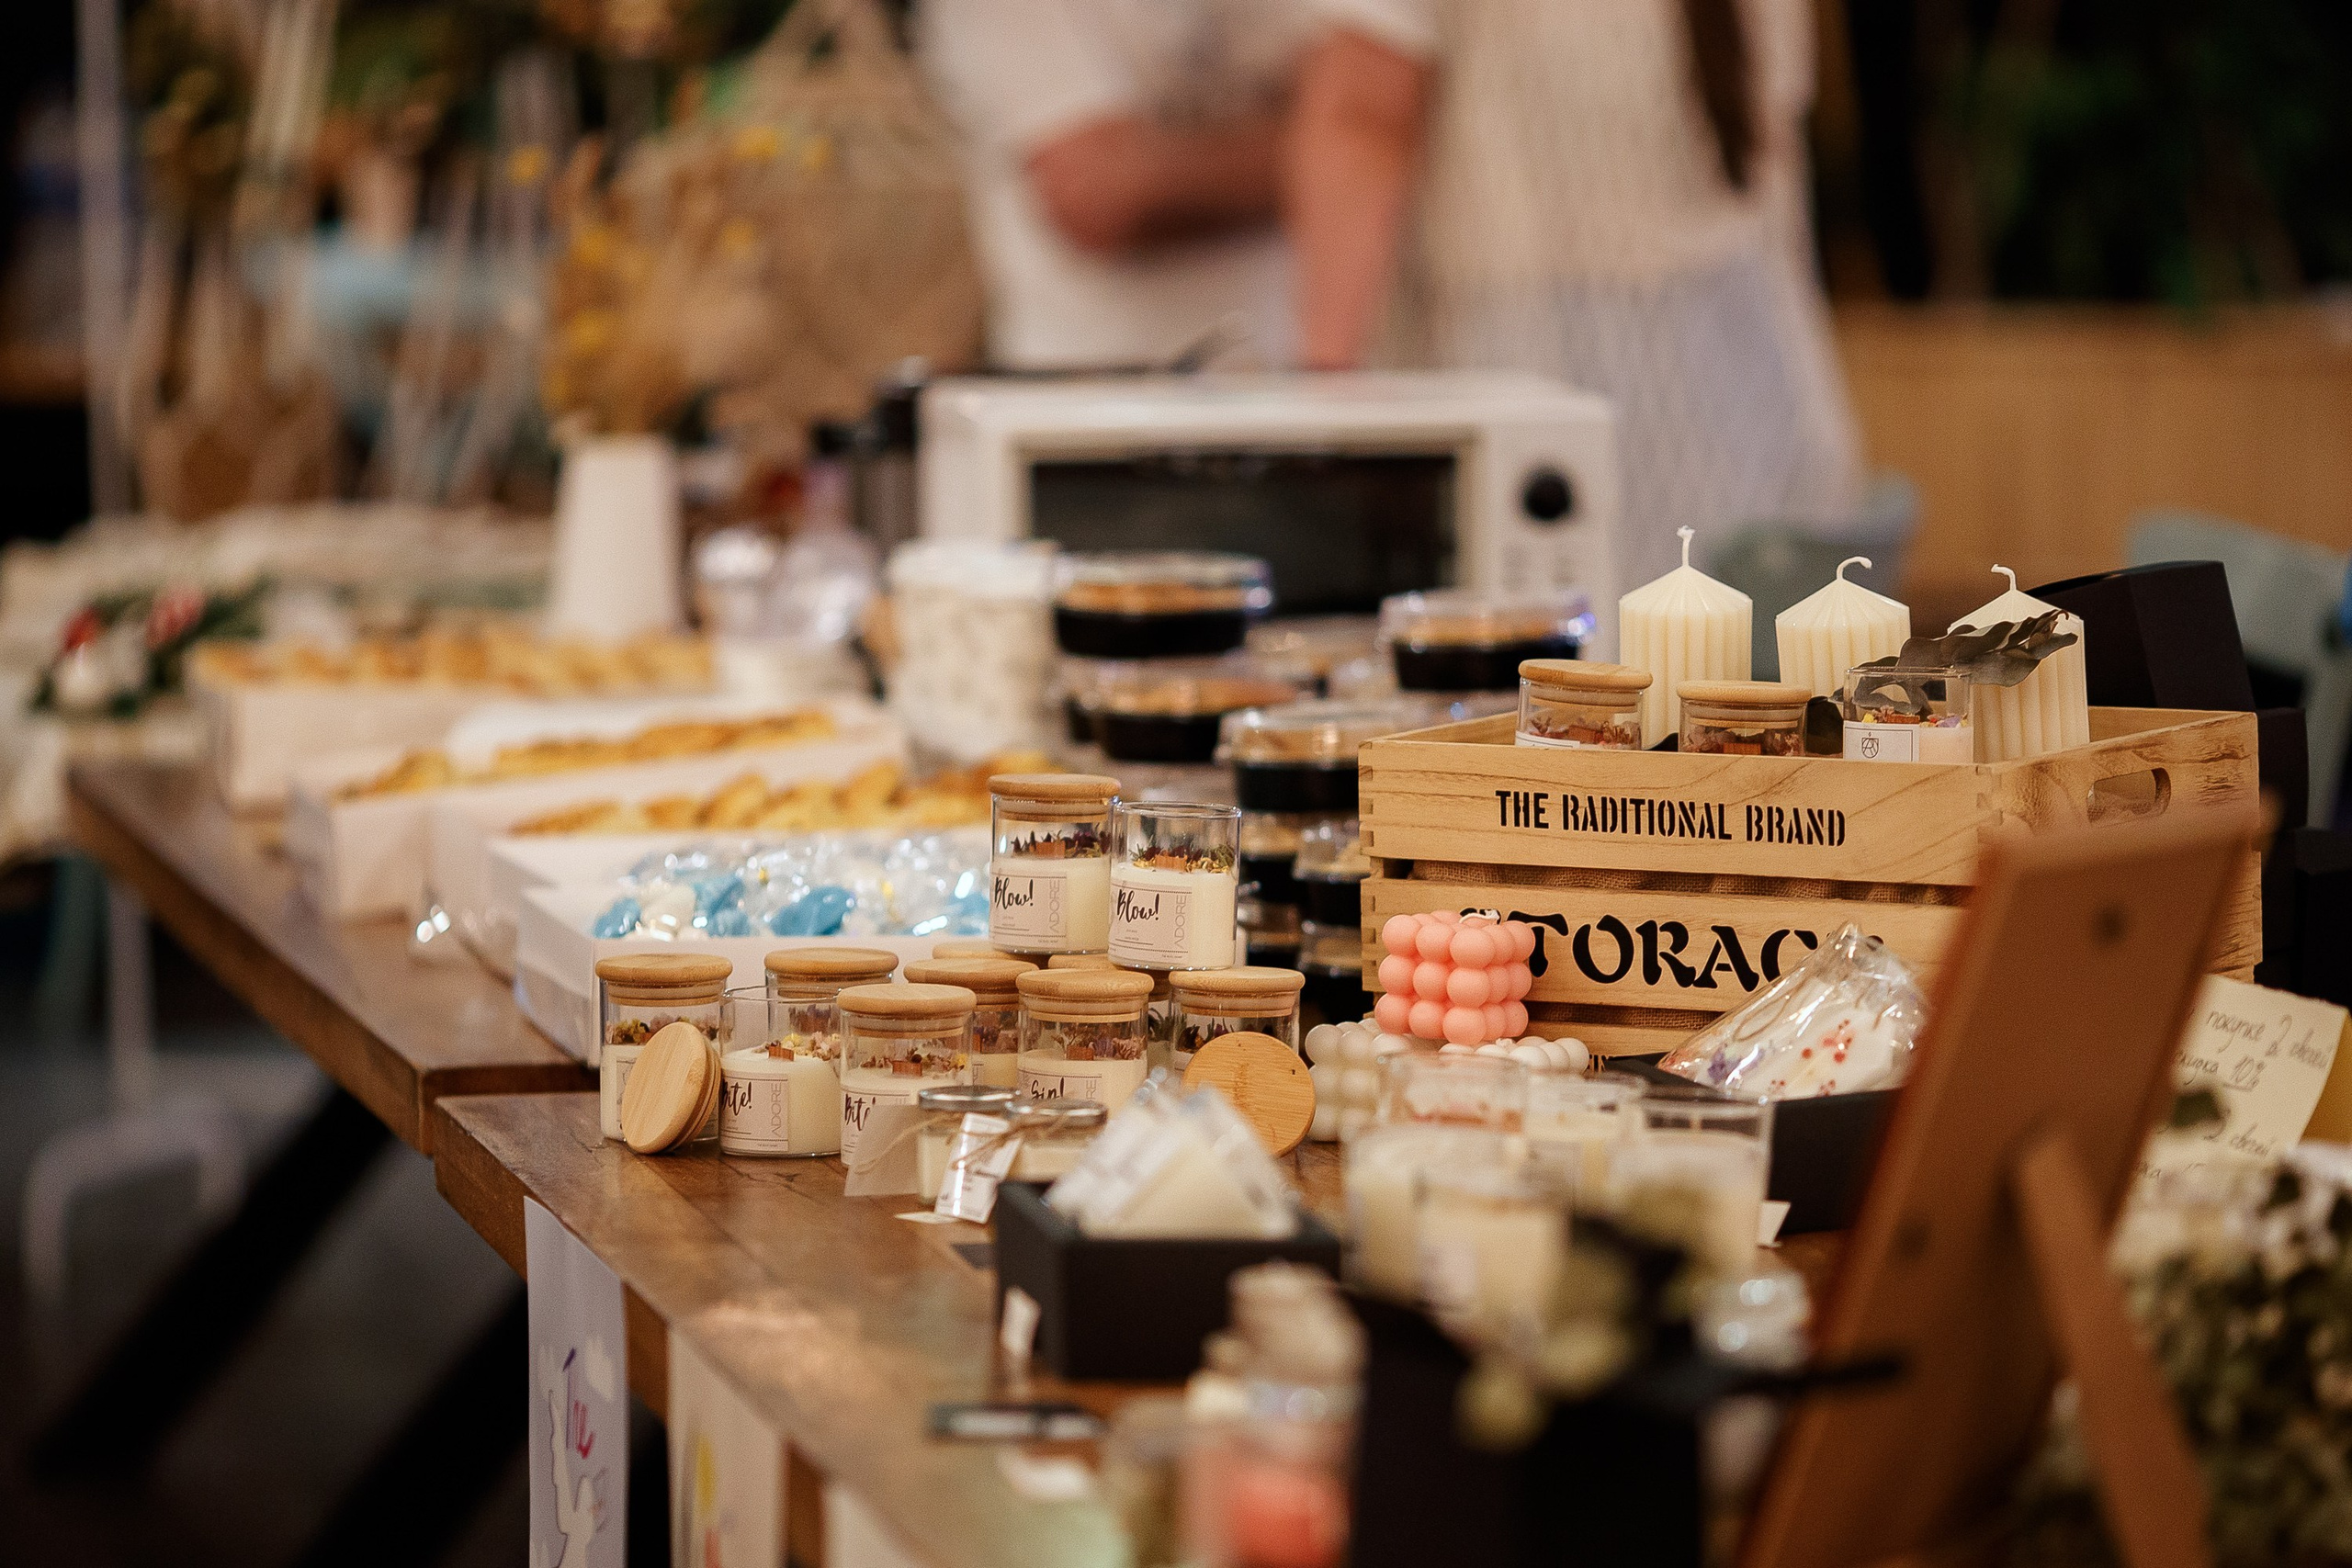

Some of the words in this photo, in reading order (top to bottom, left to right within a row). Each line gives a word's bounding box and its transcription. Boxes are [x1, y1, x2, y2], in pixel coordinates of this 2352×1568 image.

[1495, 790, 1550, 829] THE
[1562, 794, 1732, 840] RADITIONAL
[1746, 805, 1846, 847] BRAND
[994, 876, 1034, 910] Blow!
[1049, 879, 1060, 933] ADORE
[1117, 888, 1159, 923] Blow!
[1174, 894, 1187, 950] ADORE
[771, 1082, 782, 1137] ADORE
